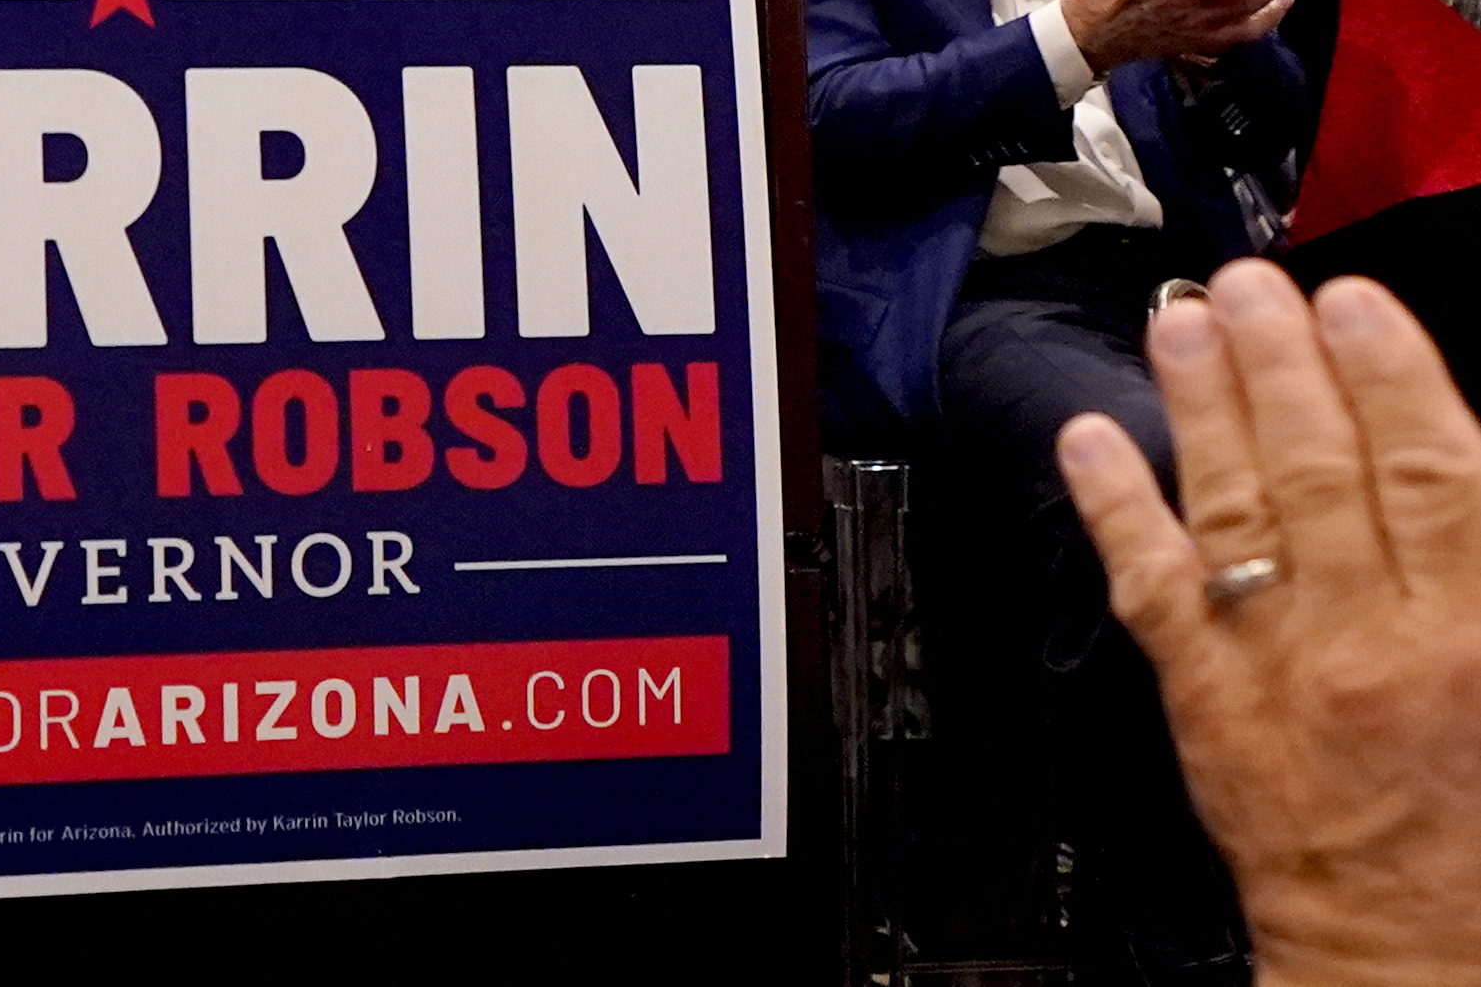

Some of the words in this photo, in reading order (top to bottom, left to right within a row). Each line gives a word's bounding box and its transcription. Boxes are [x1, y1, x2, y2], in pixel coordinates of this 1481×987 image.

[155, 363, 723, 498] ROBSON
[30, 826, 55, 842] for
[142, 818, 241, 837] Authorized
[246, 817, 267, 835] by
[273, 813, 328, 831] Karrin
[336, 812, 387, 831] Taylor
[392, 808, 462, 825] Robson.
